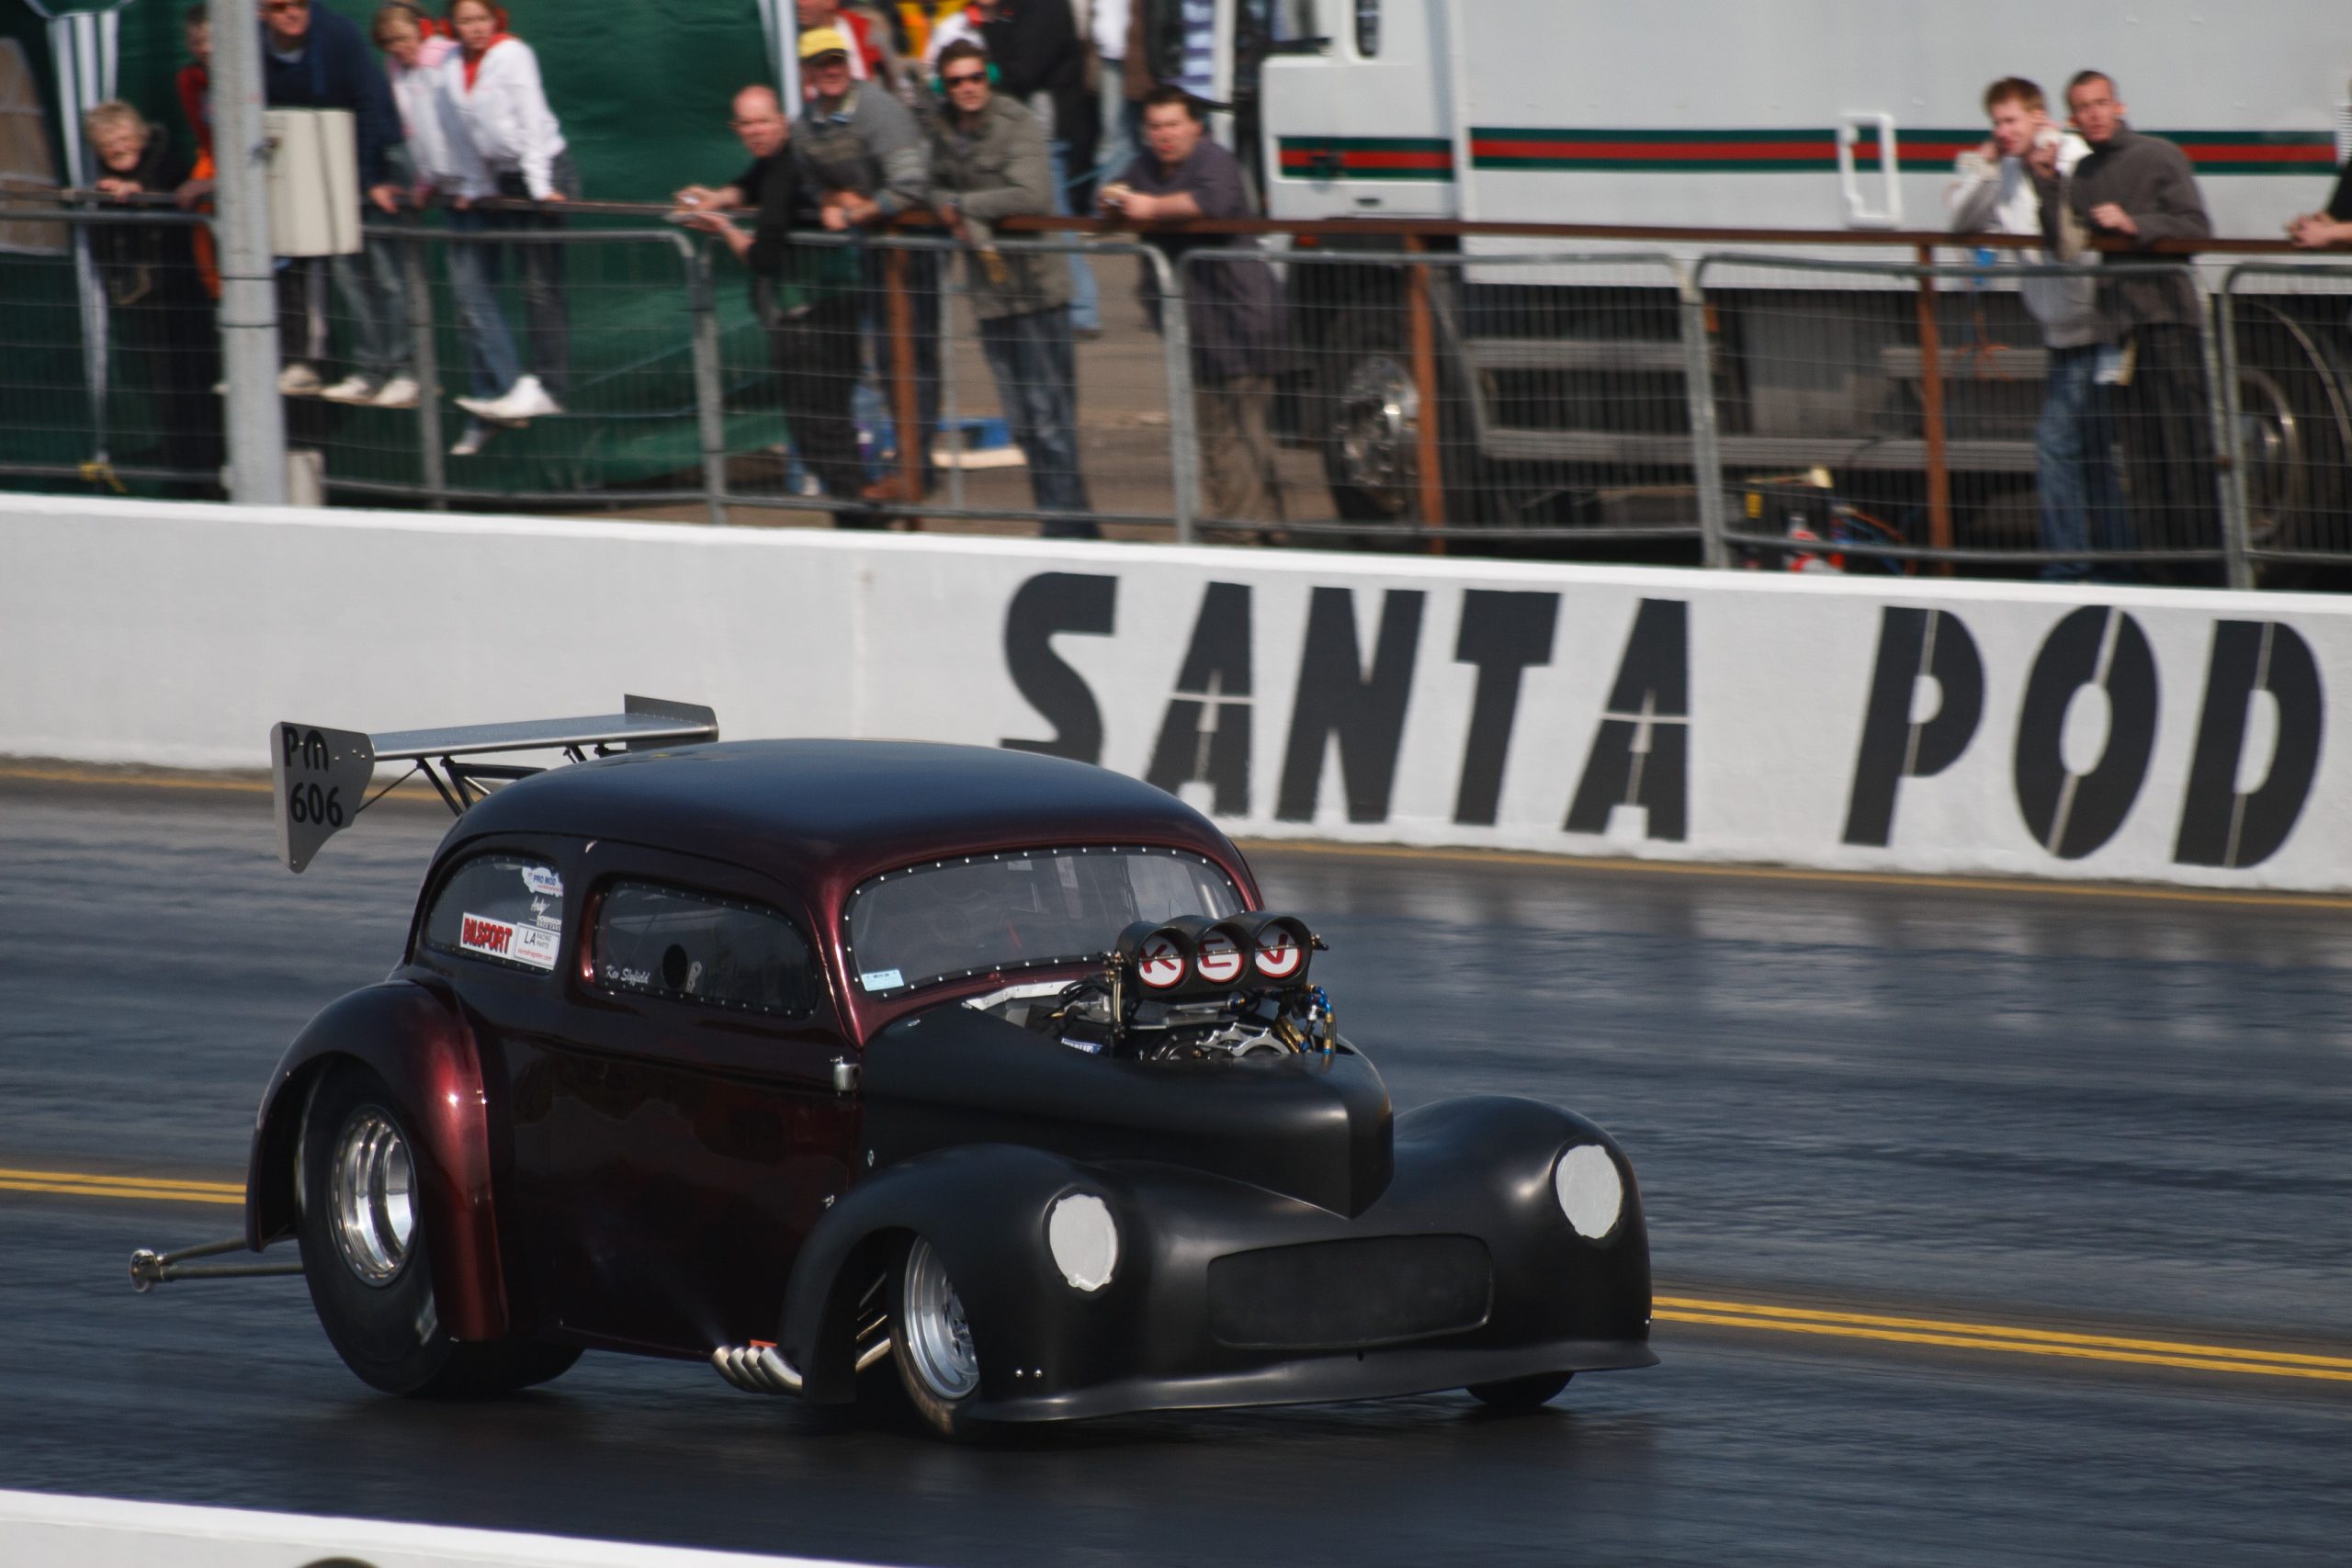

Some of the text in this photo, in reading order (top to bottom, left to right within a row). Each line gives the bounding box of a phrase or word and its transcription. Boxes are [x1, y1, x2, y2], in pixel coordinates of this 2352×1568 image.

[1001, 572, 2319, 869] SANTA POD
[290, 782, 343, 827] 606
[524, 931, 536, 946] LA
[1139, 932, 1288, 974] KEV
